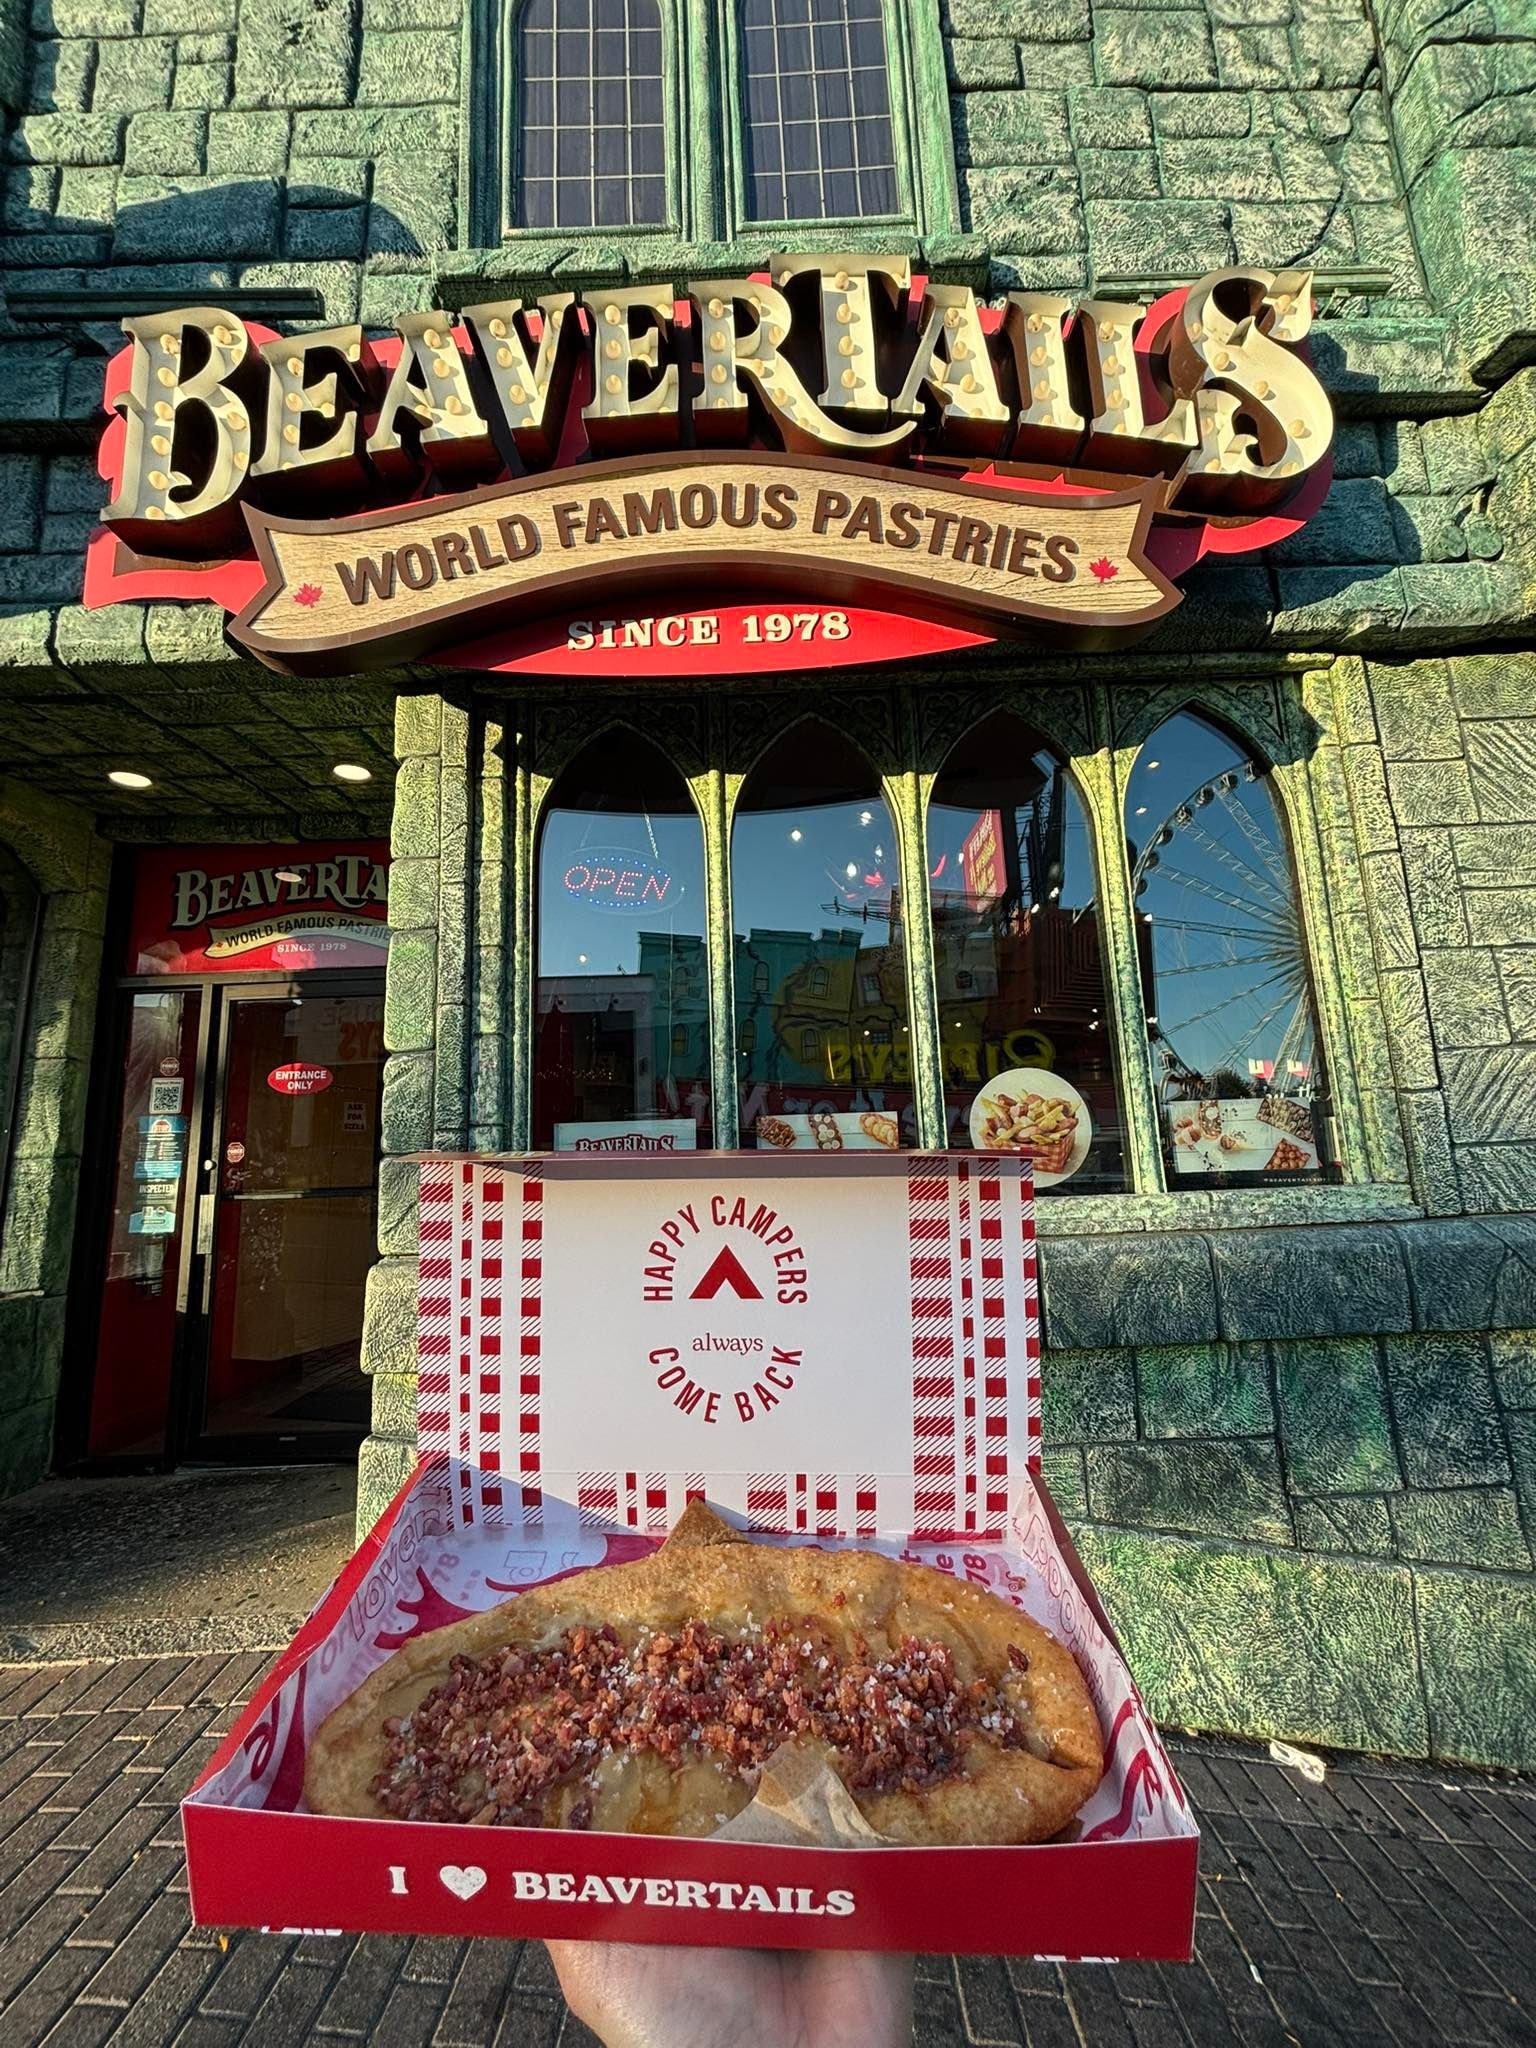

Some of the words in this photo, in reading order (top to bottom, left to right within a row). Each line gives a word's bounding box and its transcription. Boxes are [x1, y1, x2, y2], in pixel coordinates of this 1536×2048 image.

[99, 252, 1337, 526] BEAVERTAILS
[335, 513, 542, 606] WORLD
[552, 483, 799, 548] FAMOUS
[811, 489, 1080, 583] PASTRIES
[567, 615, 720, 651] SINCE
[741, 611, 852, 643] 1978
[171, 855, 389, 928] BEAVERTA
[564, 865, 672, 900] OPEN
[226, 924, 274, 949] WORLD
[277, 916, 335, 934] FAMOUS
[337, 917, 390, 941] PASTRIE
[276, 943, 315, 953] SINCE
[320, 942, 347, 951] 1978
[274, 1070, 328, 1081] ENTRANCE
[287, 1080, 314, 1091] ONLY
[643, 1203, 701, 1302] HAPPY
[710, 1194, 808, 1305] CAMPERS
[691, 1332, 764, 1357] always
[649, 1346, 722, 1424] COME
[733, 1345, 803, 1423] BACK
[388, 1865, 409, 1894] I
[511, 1871, 856, 1916] BEAVERTAILS
